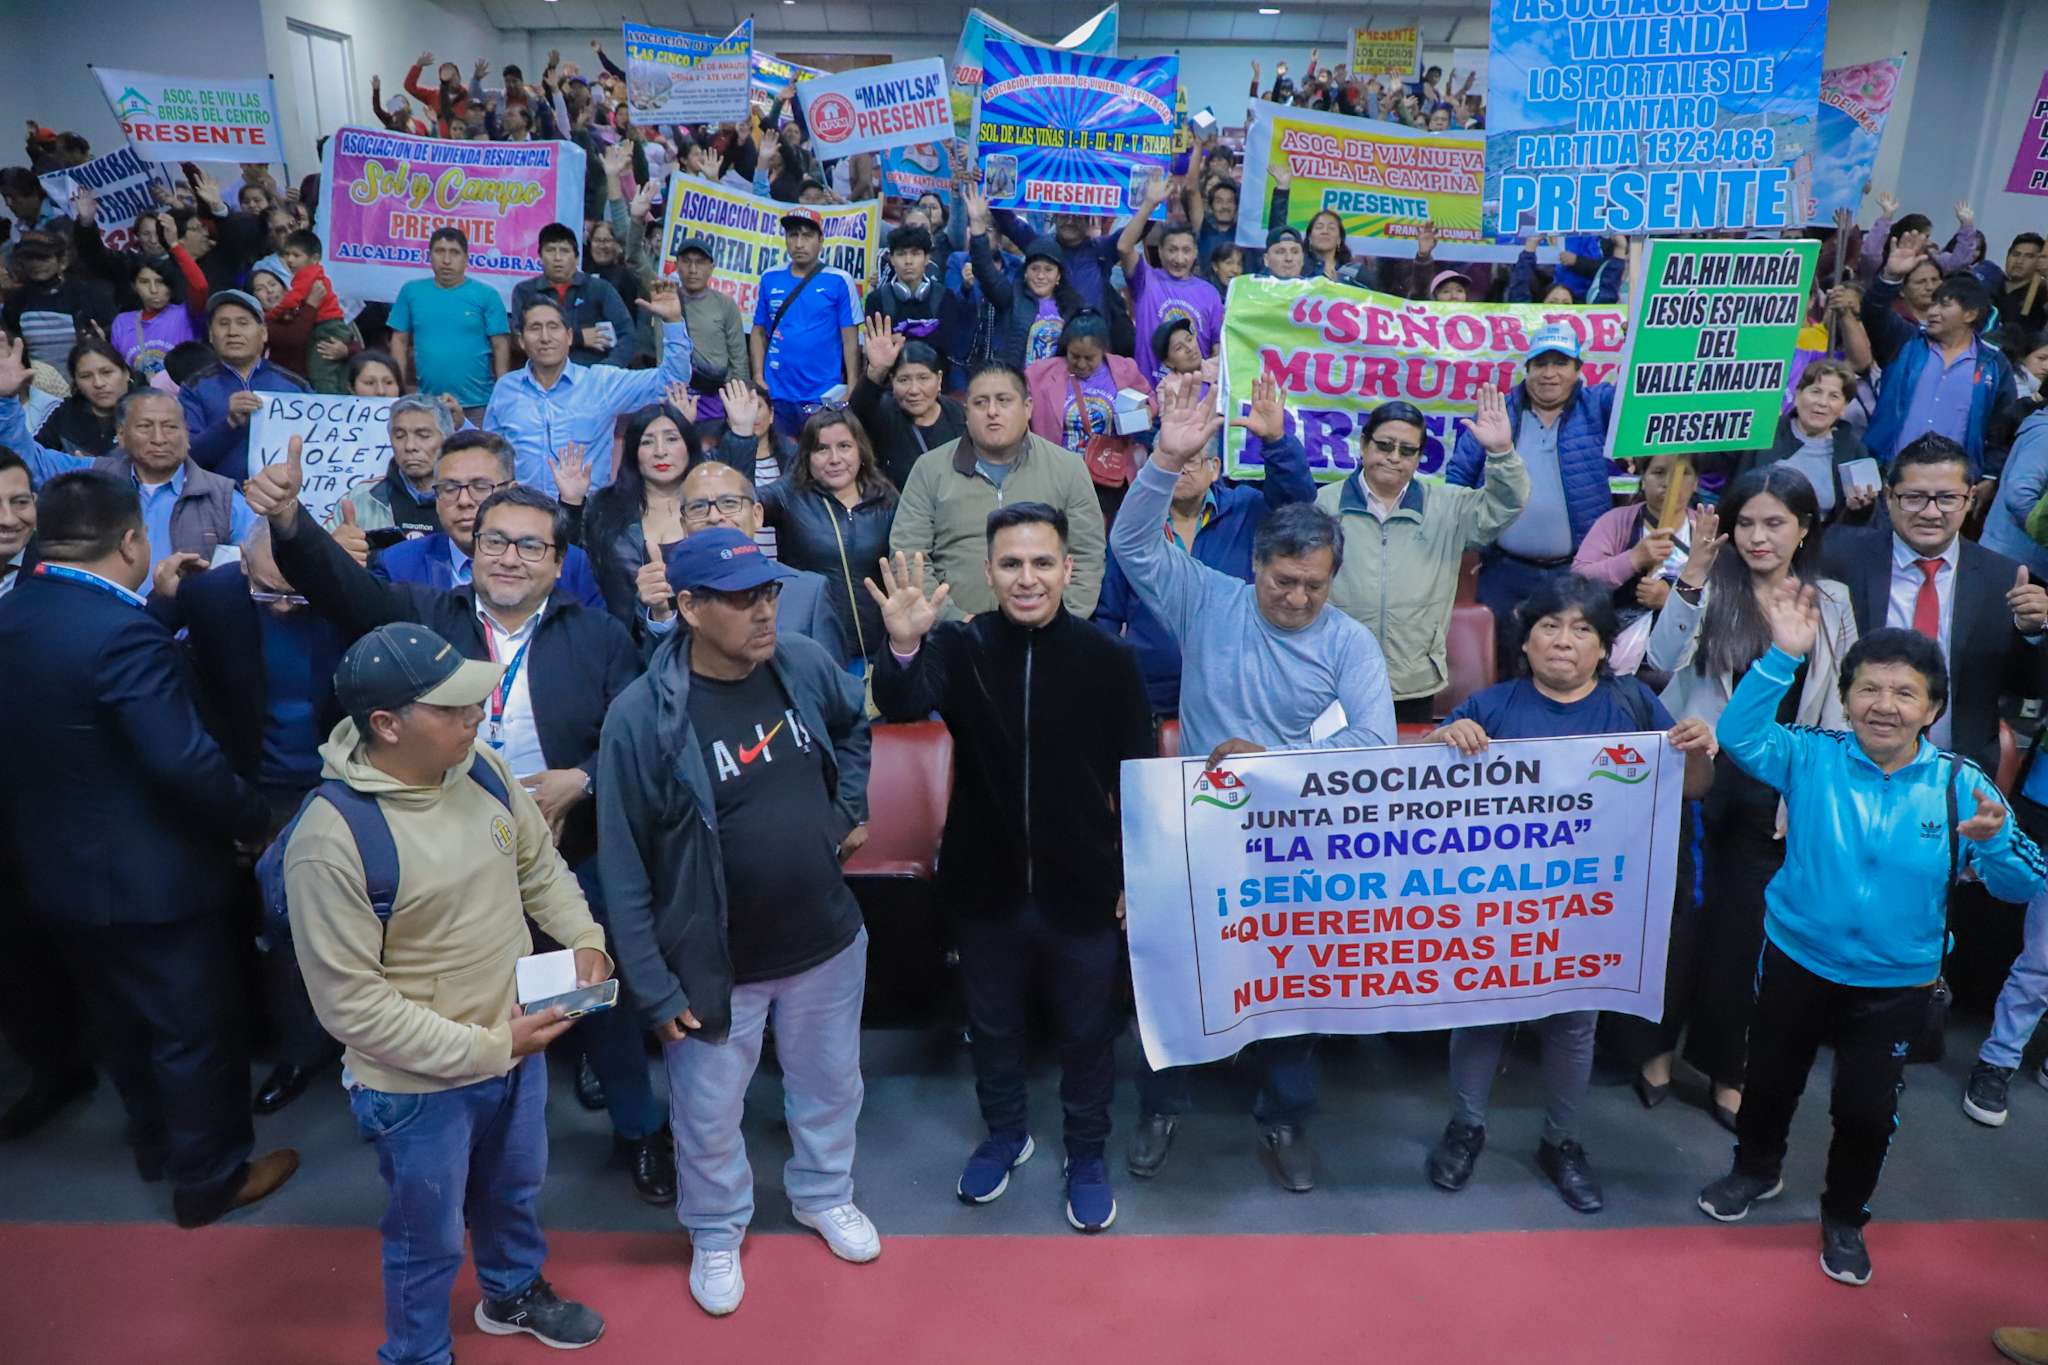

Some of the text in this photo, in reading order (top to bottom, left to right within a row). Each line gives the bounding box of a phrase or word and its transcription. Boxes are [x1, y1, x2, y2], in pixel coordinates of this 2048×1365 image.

[628, 31, 707, 50] ASOCIACIÓN DE
[1358, 28, 1414, 42] PRESENTE
[1569, 14, 1747, 60] VIVIENDA
[656, 51, 690, 67] CINCO
[1357, 48, 1413, 58] LOS CEDROS
[855, 73, 940, 109] “MANYLSA”
[1528, 58, 1774, 101] LOS PORTALES DE
[158, 105, 270, 124] BRISAS DEL CENTRO
[163, 88, 260, 108] ASOC. DE VIV LAS
[983, 73, 1173, 125] ASOCIACIÓN PROGRAMA DE VIVIENDA RESIDENCIAL
[1576, 96, 1718, 133] MANTARO
[1829, 94, 1846, 110] DE
[121, 122, 266, 145] PRESENTE
[857, 98, 949, 138] PRESENTE
[413, 143, 428, 163] DE
[431, 145, 480, 165] VIVIENDA
[483, 146, 551, 167] RESIDENCIAL
[980, 123, 999, 143] SOL
[1001, 124, 1014, 143] DE
[1015, 126, 1034, 144] LAS
[1036, 124, 1064, 147] VIÑAS
[1142, 135, 1171, 155] ETAPA
[1281, 129, 1485, 171] ASOC. DE VIV. NUEVA
[1517, 128, 1775, 168] PARTIDA 1323483
[352, 160, 545, 215] Sol y Campo
[913, 176, 936, 188] SANTA
[1289, 157, 1480, 195] VILLA LA CAMPIÑA
[1026, 181, 1121, 207] ¡PRESENTE!
[1322, 189, 1429, 219] PRESENTE
[1500, 168, 1790, 233] PRESENTE
[679, 190, 759, 233] ASOCIACIÓN
[760, 213, 777, 236] DE
[1443, 229, 1482, 240] CUMPLE
[338, 244, 421, 262] ALCALDE
[757, 245, 779, 276] DE
[1660, 248, 1802, 288] AA.HH MARÍA
[1293, 298, 1529, 352] “SEÑOR
[1645, 289, 1800, 328] JESÚS ESPINOZA
[1695, 328, 1738, 360] DEL
[1634, 360, 1785, 396] VALLE AMAUTA
[269, 397, 392, 422] ASOCIAC
[303, 423, 363, 444] LAS
[1644, 410, 1753, 445] PRESENTE
[261, 443, 393, 467] VOLET
[327, 465, 355, 473] DE
[402, 523, 433, 531] marathon
[732, 546, 757, 555] BOSCH
[1300, 755, 1541, 798] ASOCIACIÓN
[1241, 793, 1593, 830] JUNTA DE PROPIETARIOS
[1246, 819, 1591, 863] “LA RONCADORA”
[1240, 869, 1387, 907] SEÑOR
[1400, 857, 1599, 896] ALCALDE
[1613, 855, 1625, 881] !
[1221, 891, 1614, 943] “QUEREMOS PISTAS
[1267, 928, 1559, 969] Y VEREDAS EN
[1233, 953, 1622, 1014] NUESTRAS CALLES”
